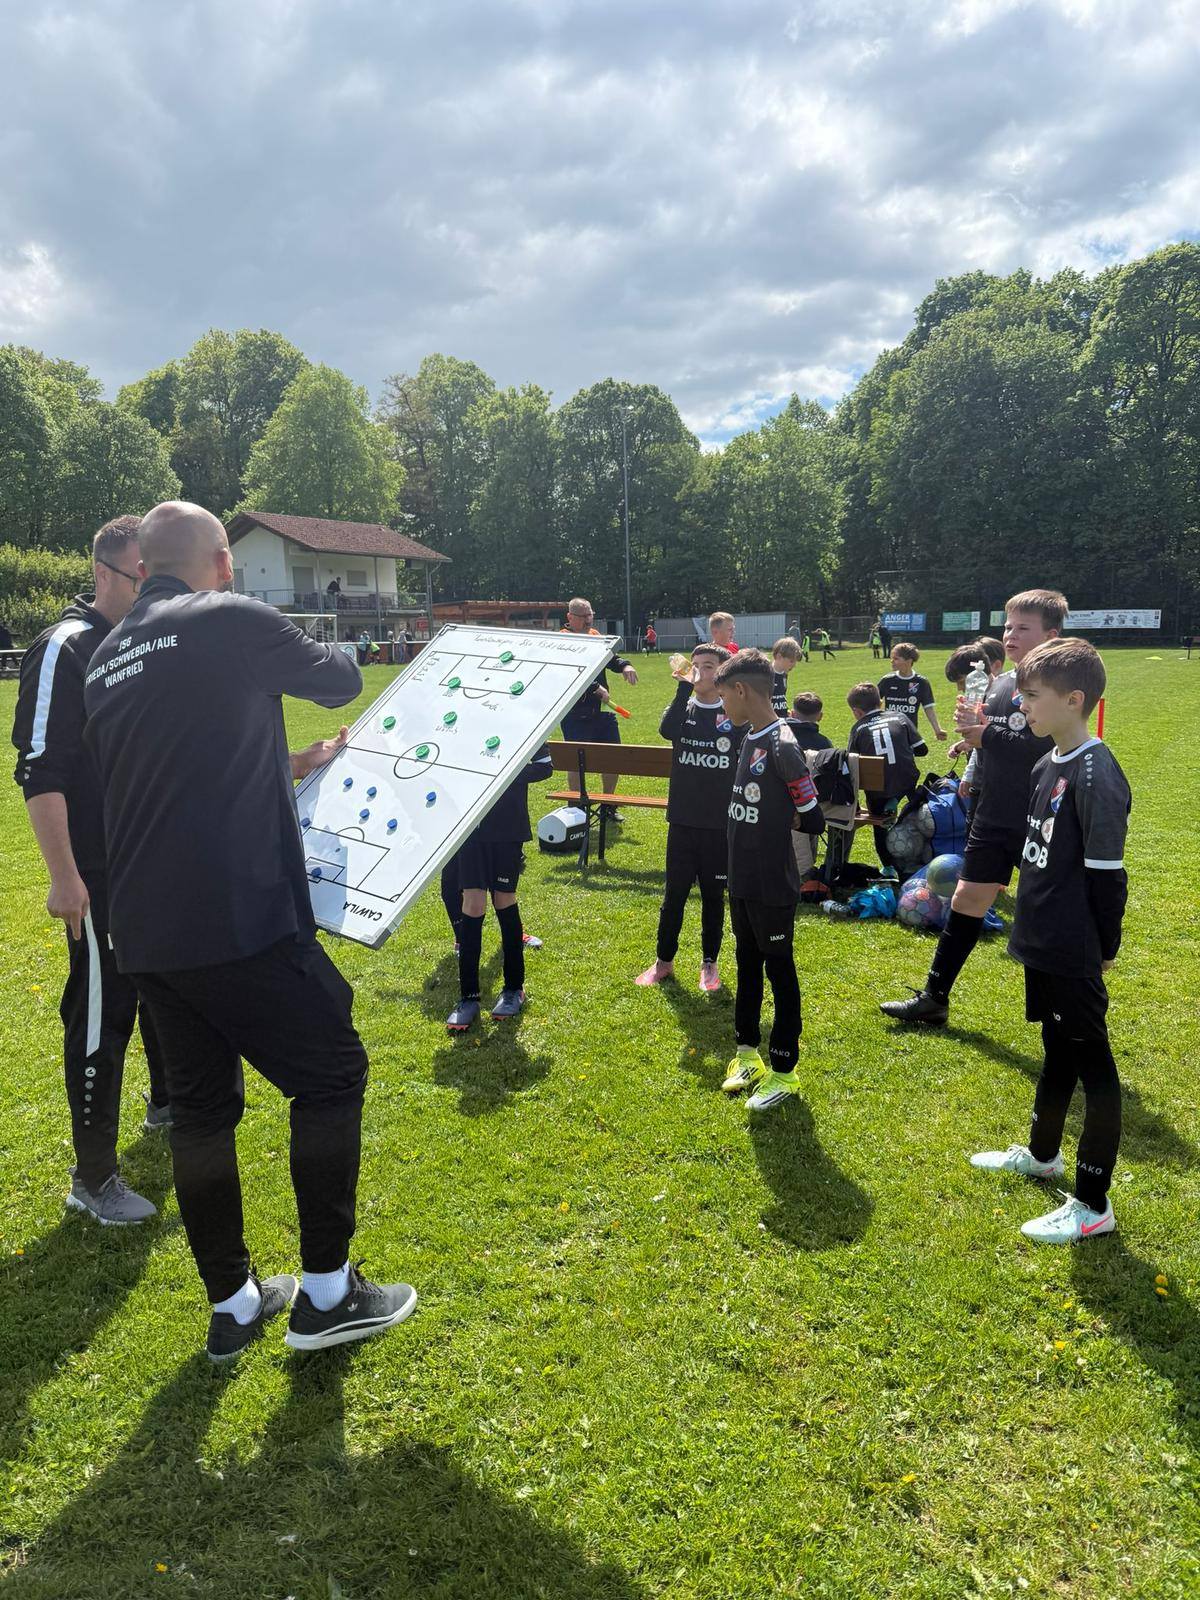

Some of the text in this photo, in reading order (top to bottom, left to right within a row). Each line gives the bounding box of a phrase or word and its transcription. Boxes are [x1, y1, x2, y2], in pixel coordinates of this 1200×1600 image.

[118, 636, 132, 652] JSG
[105, 660, 143, 688] WANFRIED
[886, 703, 915, 713] JAKOB
[680, 737, 715, 749] expert
[873, 727, 896, 765] 4
[678, 750, 730, 769] JAKOB
[727, 801, 759, 824] KOB
[342, 901, 383, 921] CAWILA
[770, 1047, 790, 1057] JAKO
